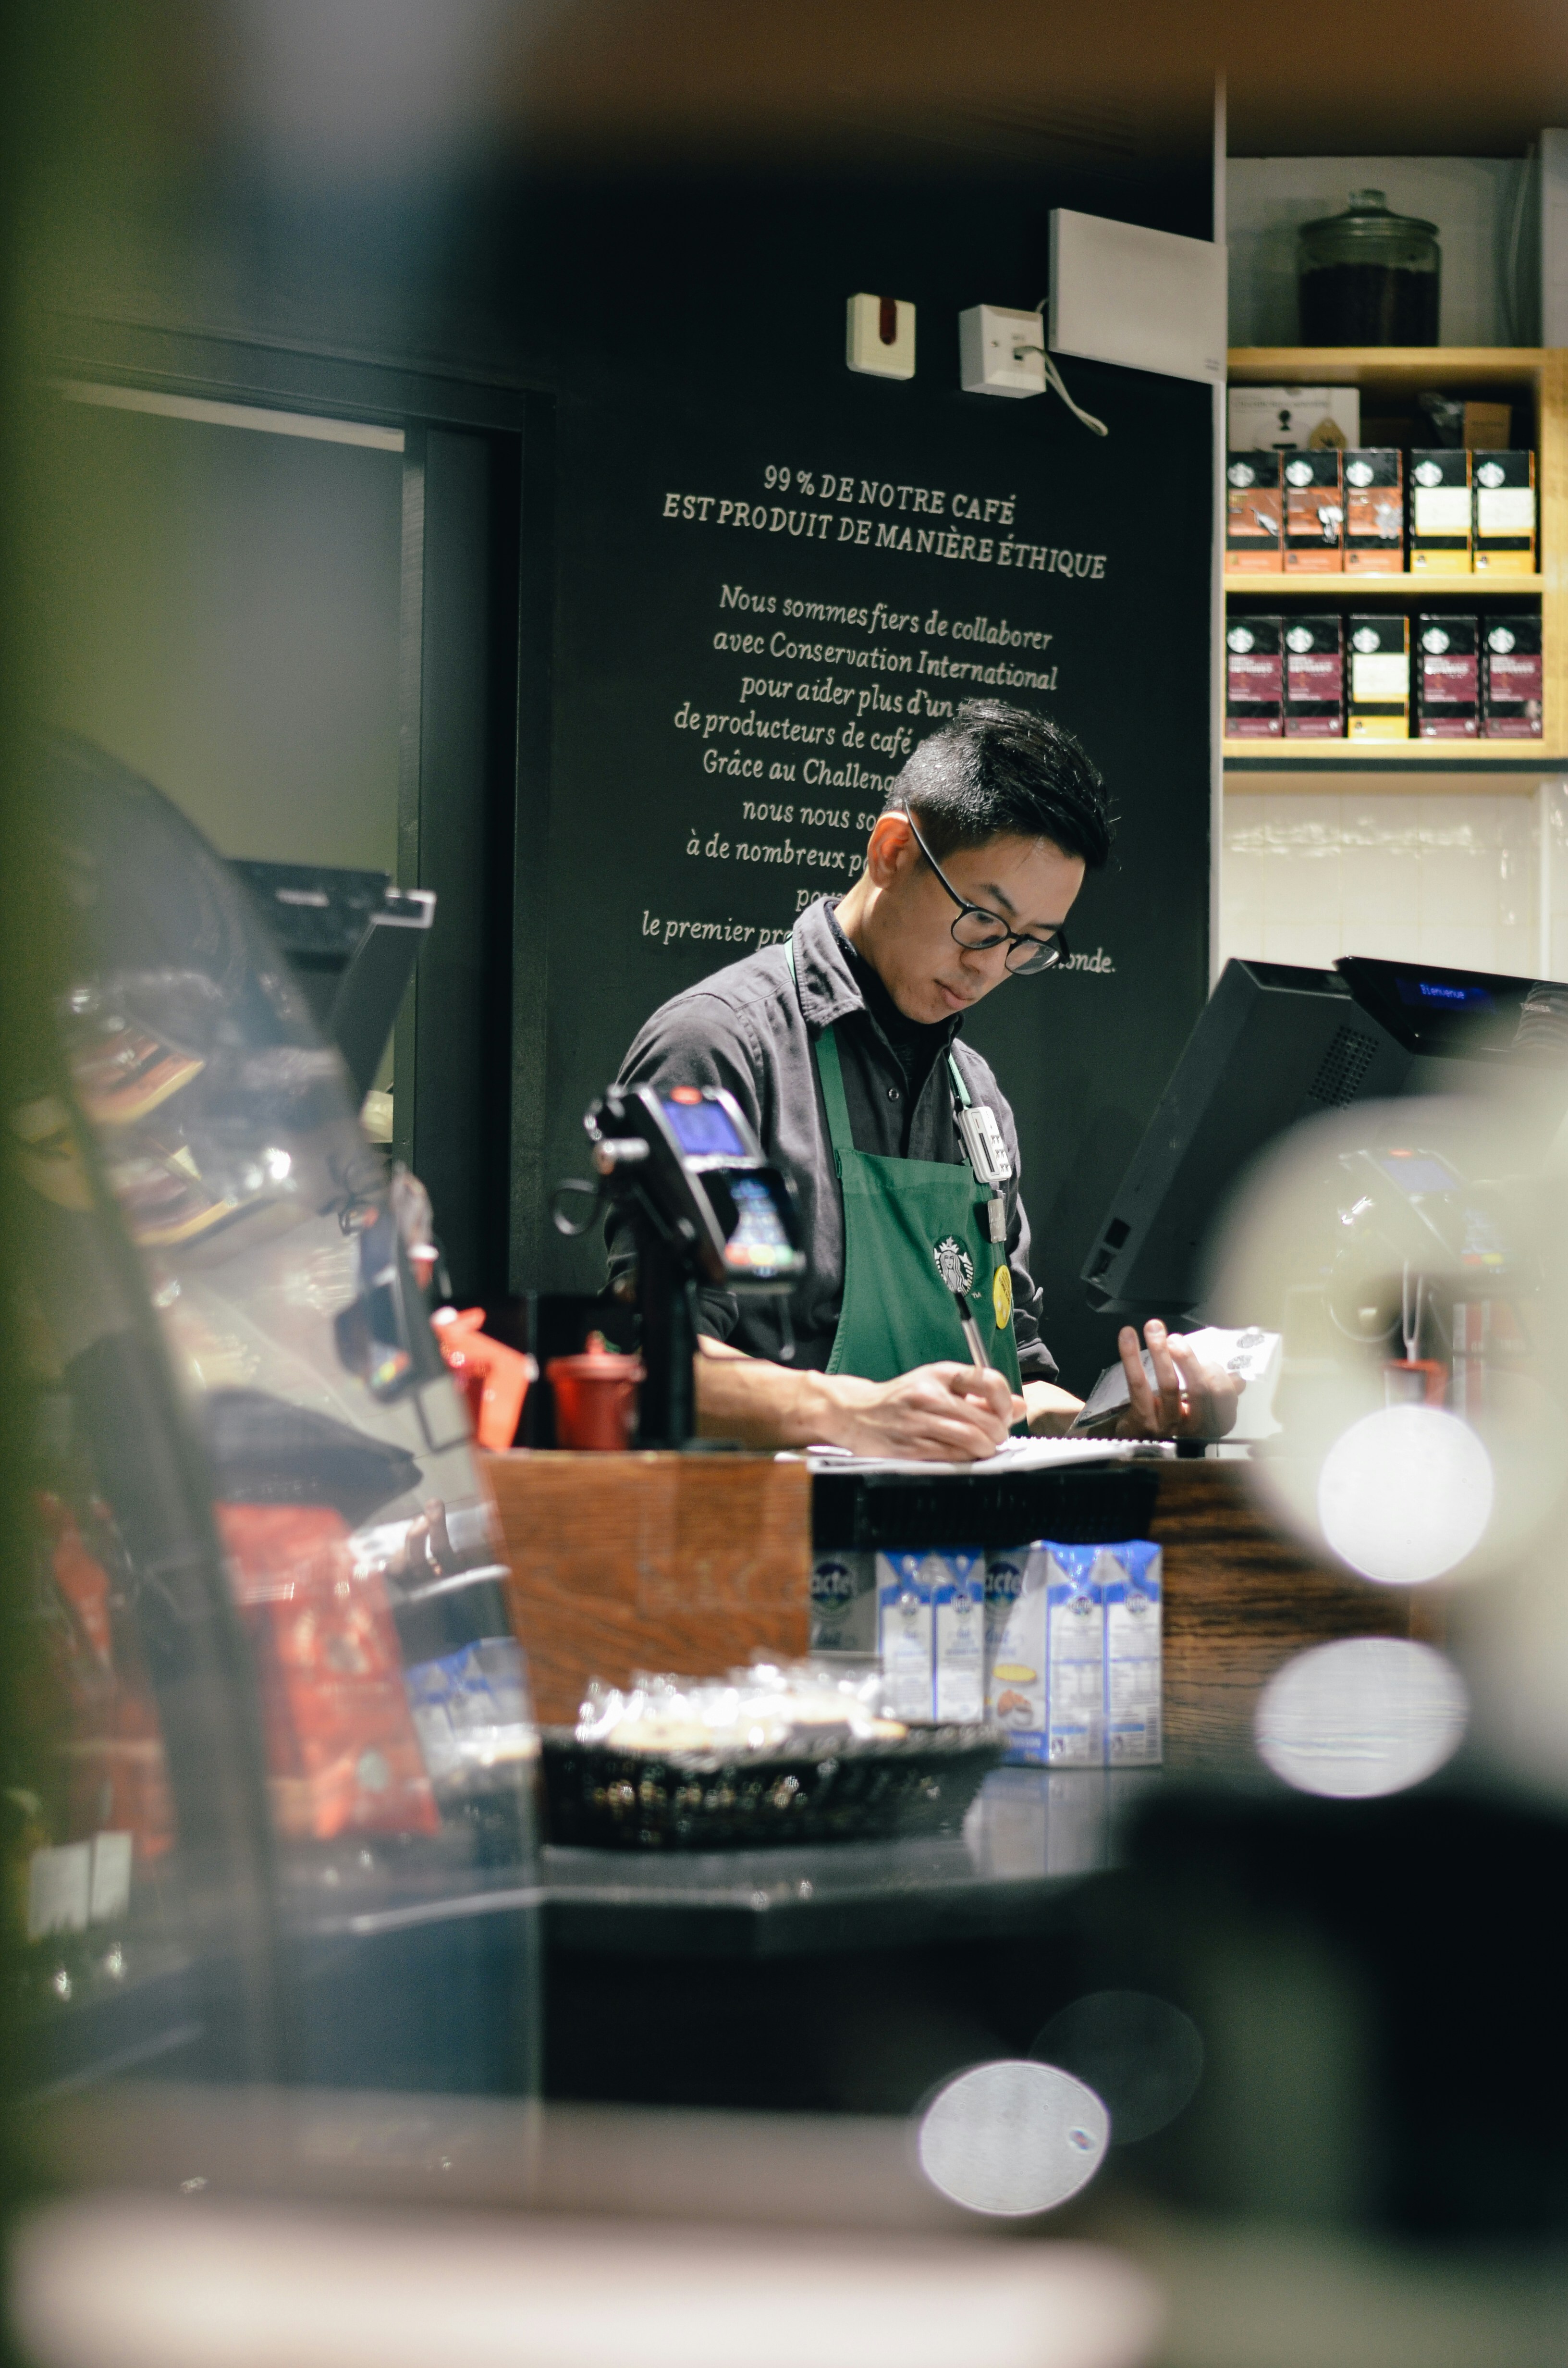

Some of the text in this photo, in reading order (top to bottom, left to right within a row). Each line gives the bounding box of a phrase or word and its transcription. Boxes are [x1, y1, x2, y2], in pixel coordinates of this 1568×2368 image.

[764, 465, 1016, 524] 99 % DE NOTRE CAFÉ
[663, 493, 1106, 578] EST PRODUIT DE MANIÈRE ÉTHIQUE
[720, 584, 1052, 649] Nous sommes fiers de collaborer
[713, 632, 1057, 690] avec Conservation International
[740, 677, 793, 703] pour
[796, 677, 855, 704] aider
[857, 684, 902, 716] plus
[907, 689, 953, 717] d'un
[674, 702, 700, 730] de
[702, 710, 835, 745] producteurs
[842, 721, 865, 748] de
[870, 727, 913, 758] café
[703, 749, 763, 777] Grâce
[769, 763, 796, 781] au
[743, 802, 794, 823] nous
[800, 808, 850, 828] nous
[686, 828, 700, 855] à
[705, 833, 730, 859] de
[736, 839, 845, 869] nombreux
[642, 910, 660, 936] le
[663, 918, 755, 945] premier
